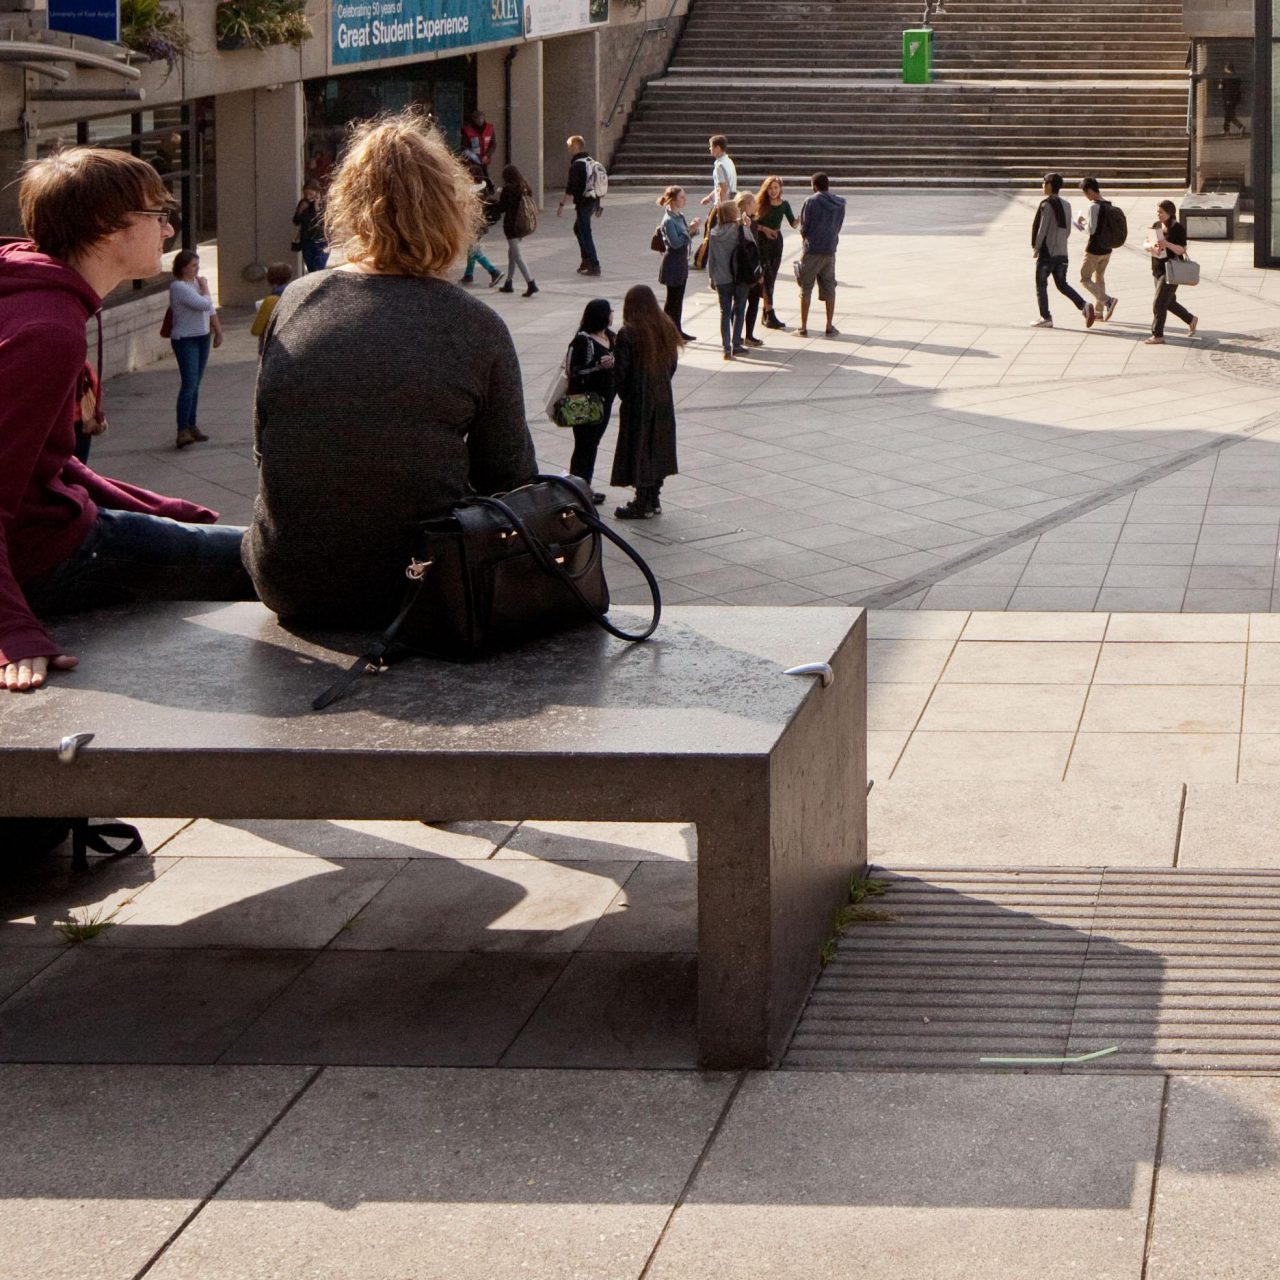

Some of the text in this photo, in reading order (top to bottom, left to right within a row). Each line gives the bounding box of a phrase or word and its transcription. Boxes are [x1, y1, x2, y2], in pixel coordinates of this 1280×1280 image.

[338, 0, 403, 20] Celebrating 50 years of
[338, 13, 469, 49] Great Student Experience
